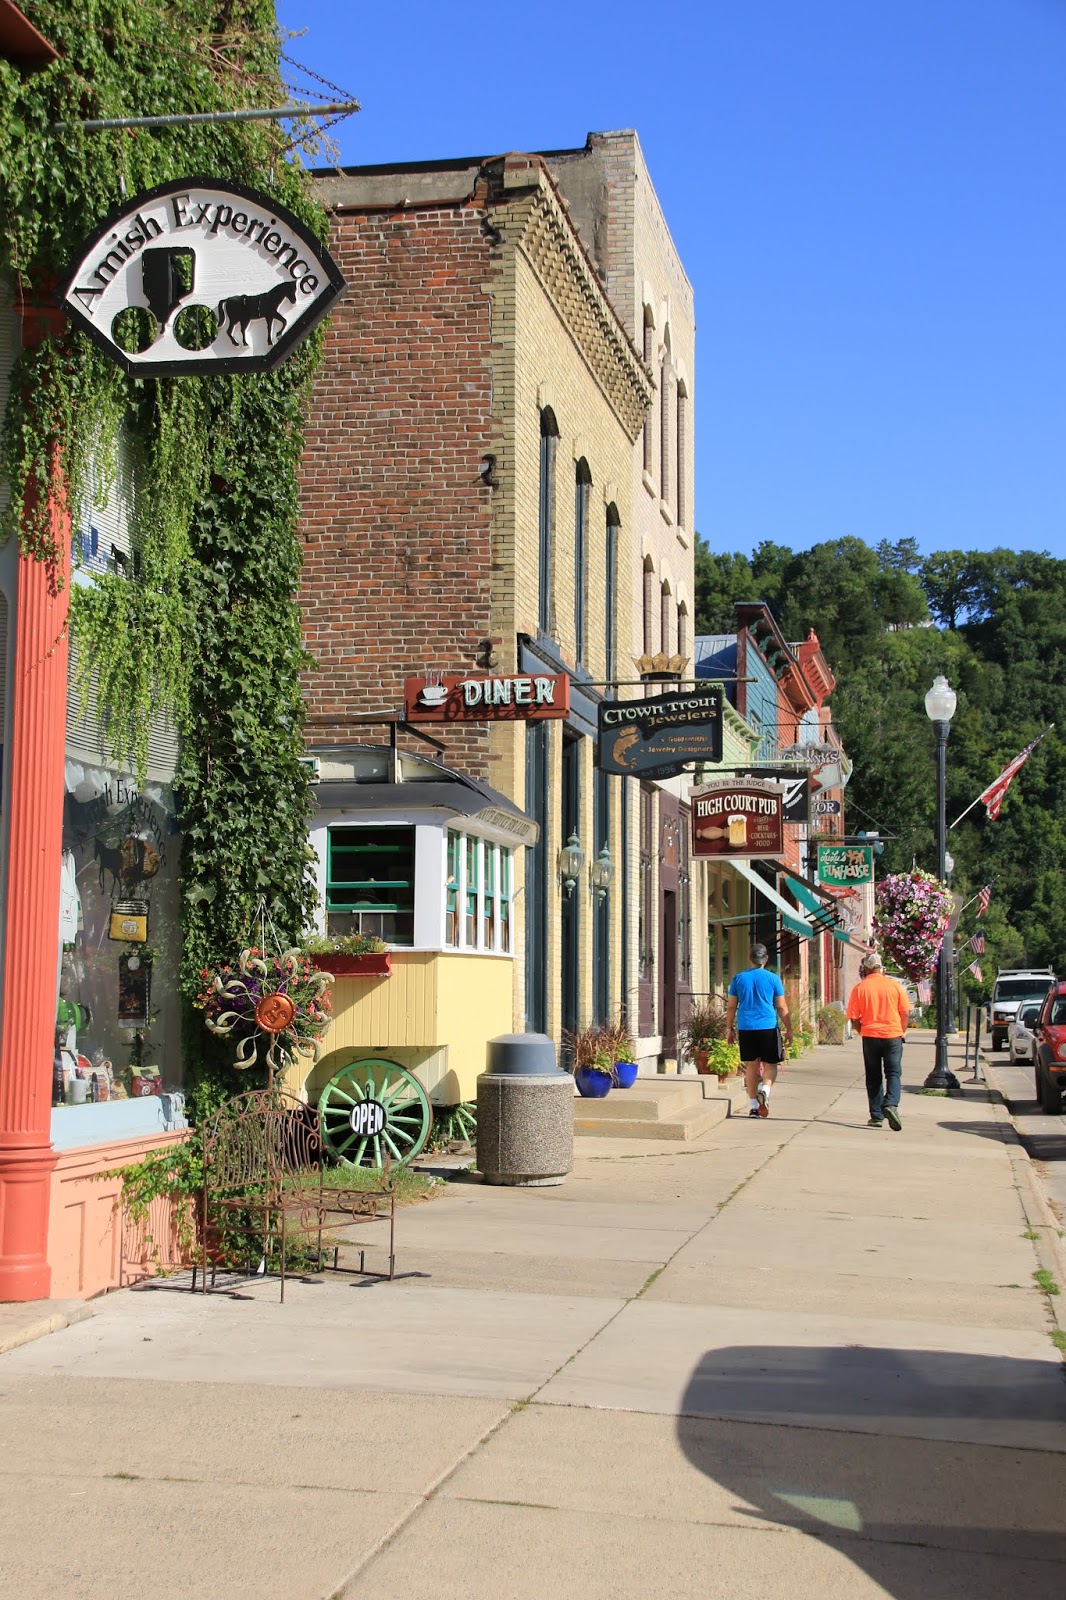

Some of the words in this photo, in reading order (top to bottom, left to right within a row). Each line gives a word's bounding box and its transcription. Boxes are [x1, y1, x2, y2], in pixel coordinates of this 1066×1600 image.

[72, 213, 164, 316] Amish
[172, 195, 320, 294] Experience
[463, 677, 555, 706] DINER
[603, 705, 663, 724] Crown
[667, 697, 717, 712] Trout
[647, 710, 717, 726] Jewelers
[657, 764, 676, 775] 1996
[746, 780, 766, 788] JUDGE
[697, 797, 722, 816] HIGH
[724, 794, 757, 812] COURT
[758, 799, 777, 815] PUB
[822, 864, 870, 880] FUNHOUSE
[352, 1102, 384, 1135] OPEN
